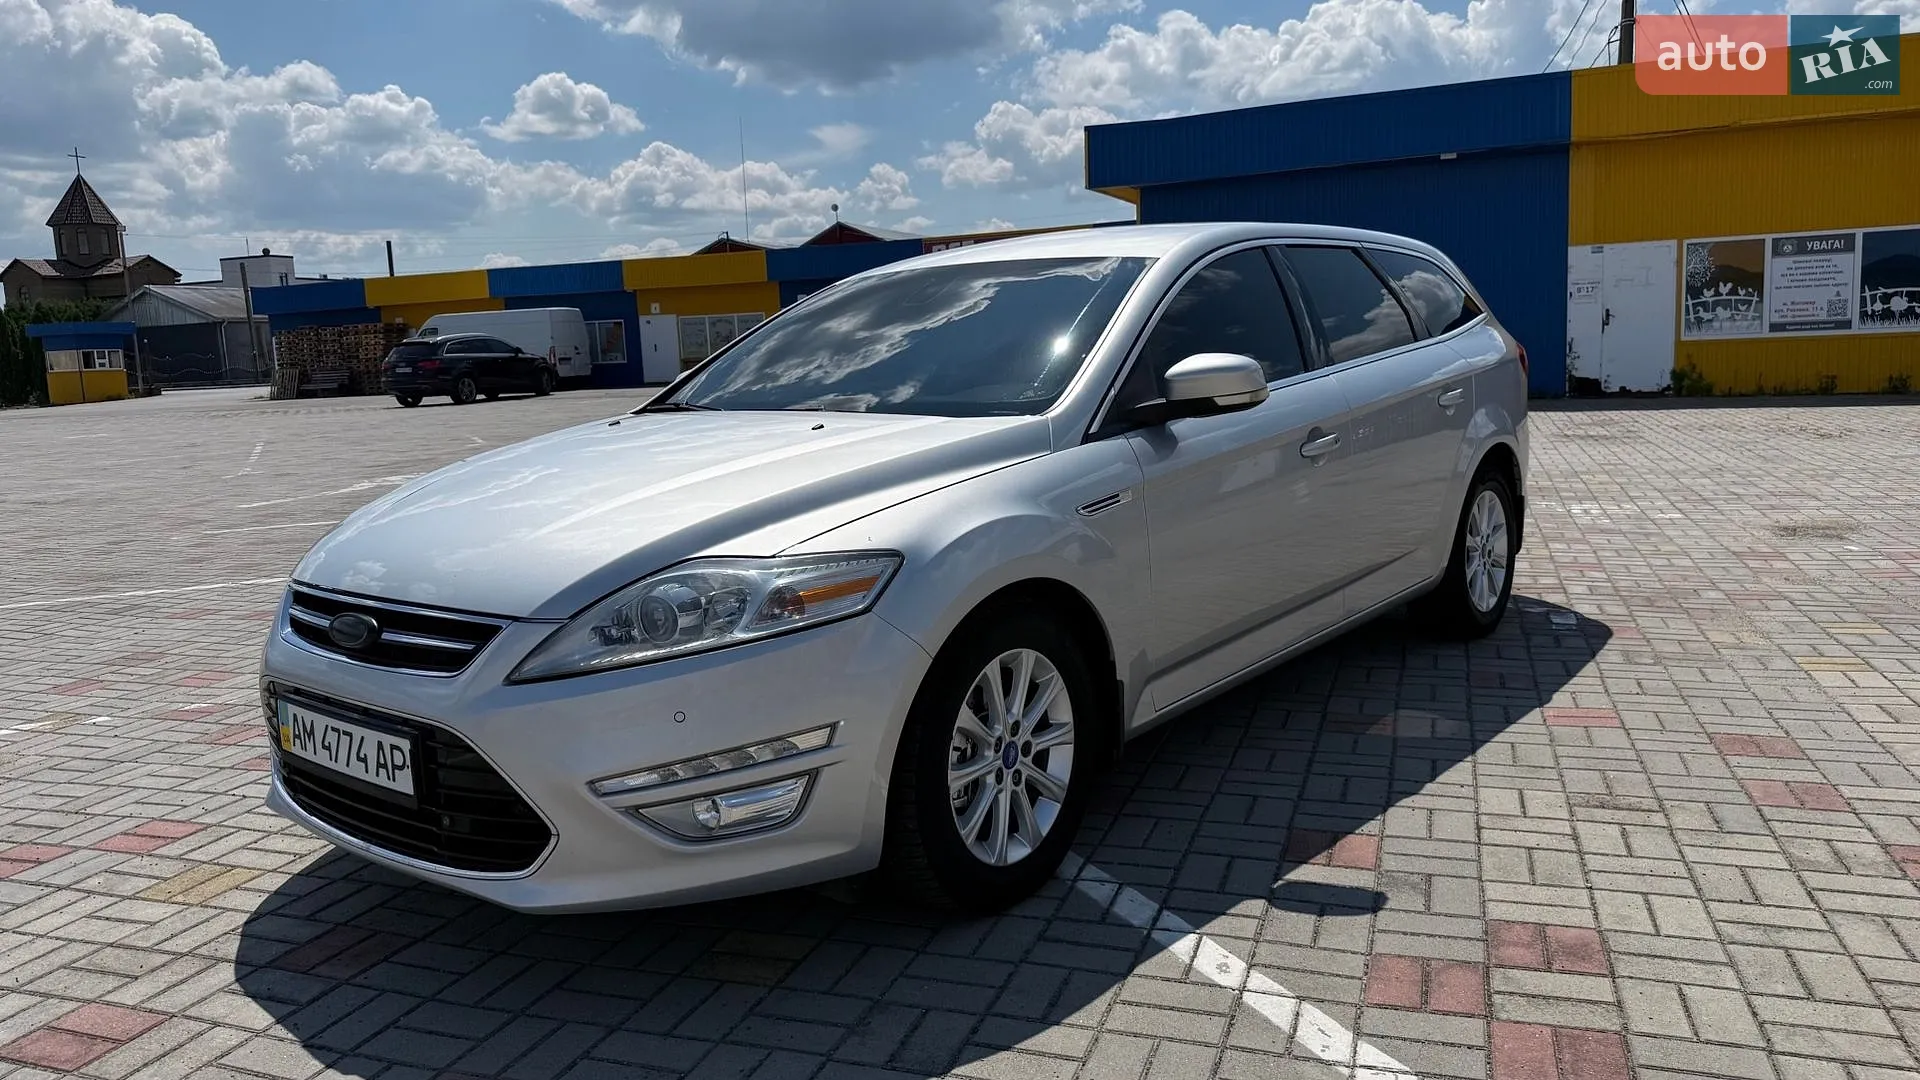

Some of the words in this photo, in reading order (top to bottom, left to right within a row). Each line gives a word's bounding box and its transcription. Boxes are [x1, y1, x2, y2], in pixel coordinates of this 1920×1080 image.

[1806, 239, 1844, 251] УВАГА!
[292, 712, 317, 756] AM
[321, 724, 369, 774] 4774
[375, 740, 407, 783] AP
